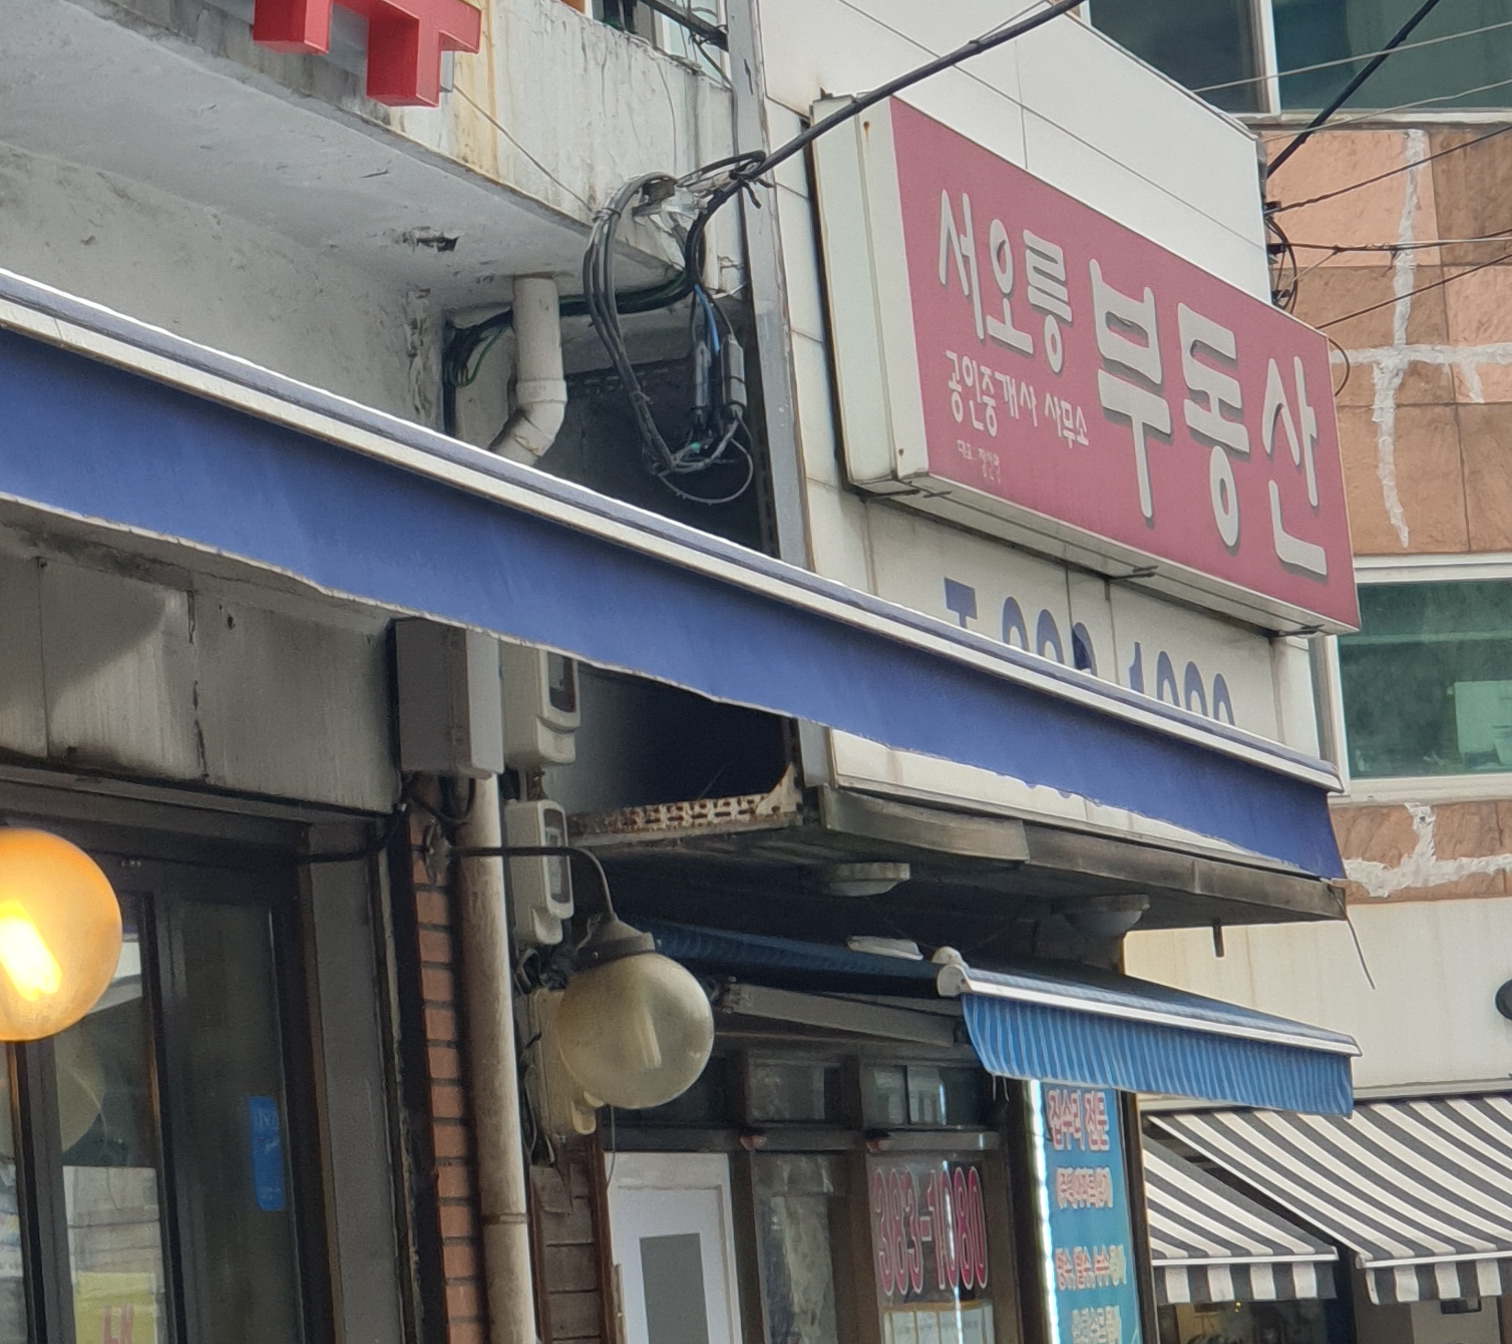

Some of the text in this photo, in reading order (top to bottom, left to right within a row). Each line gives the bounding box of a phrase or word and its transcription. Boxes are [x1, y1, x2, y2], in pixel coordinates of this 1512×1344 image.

[938, 188, 1329, 577] 서오릉 부동산
[945, 350, 1090, 450] 공인중개사 사무소
